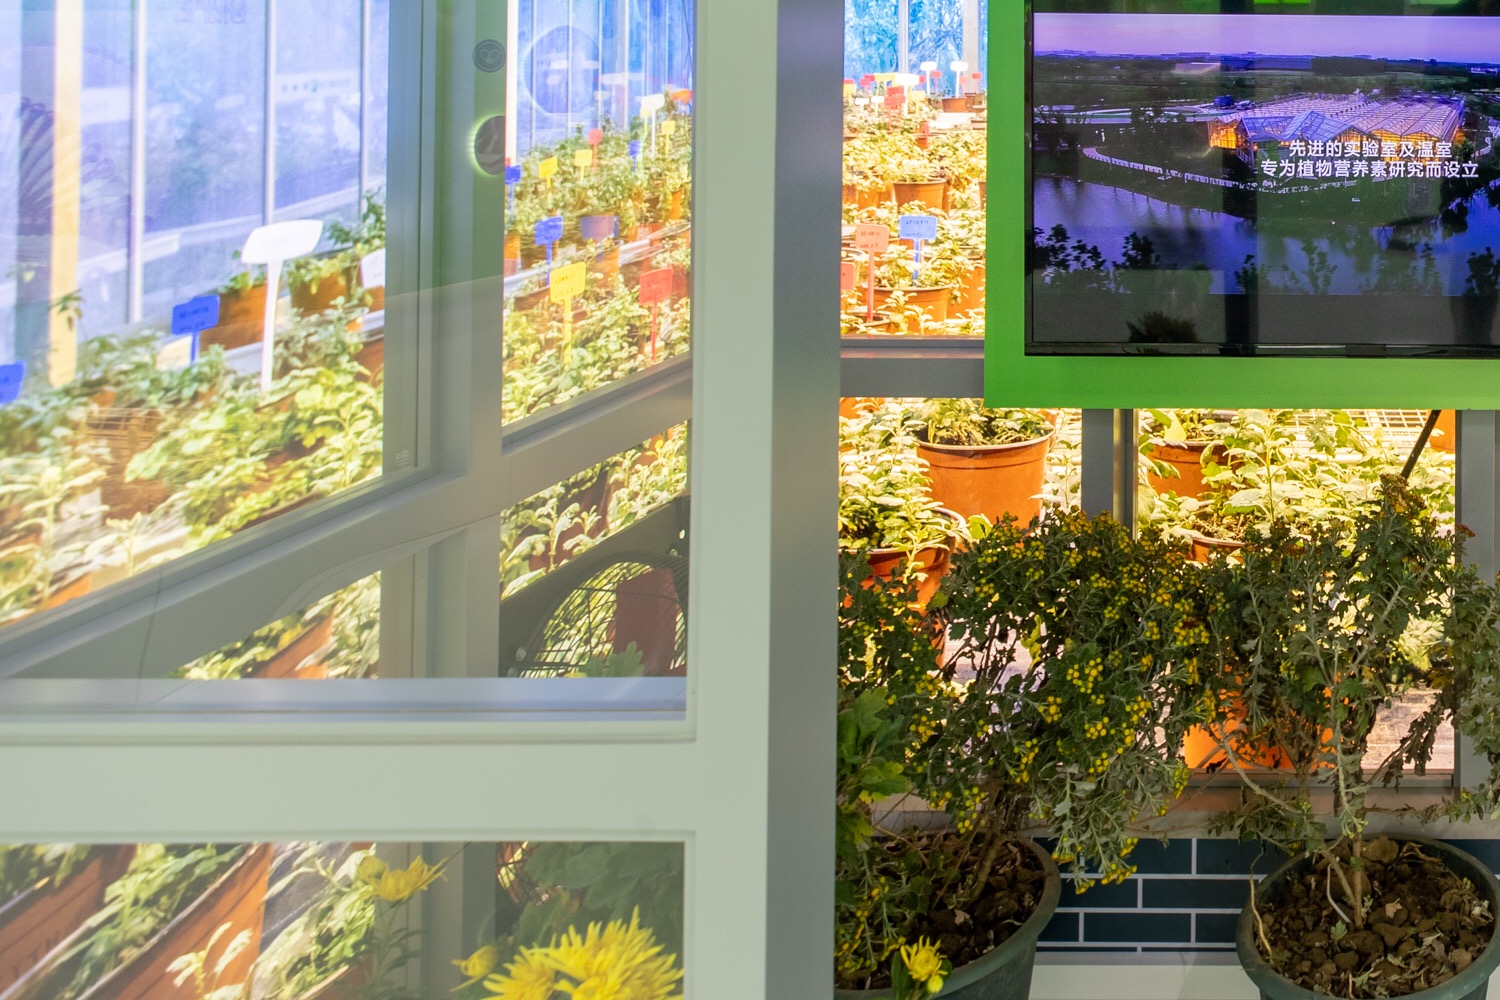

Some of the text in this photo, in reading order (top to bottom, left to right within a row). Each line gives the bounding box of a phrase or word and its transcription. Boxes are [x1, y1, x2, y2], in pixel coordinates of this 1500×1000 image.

[1288, 140, 1453, 159] 先进的实验室及温室
[1260, 159, 1479, 179] 专为植物营养素研究而设立
